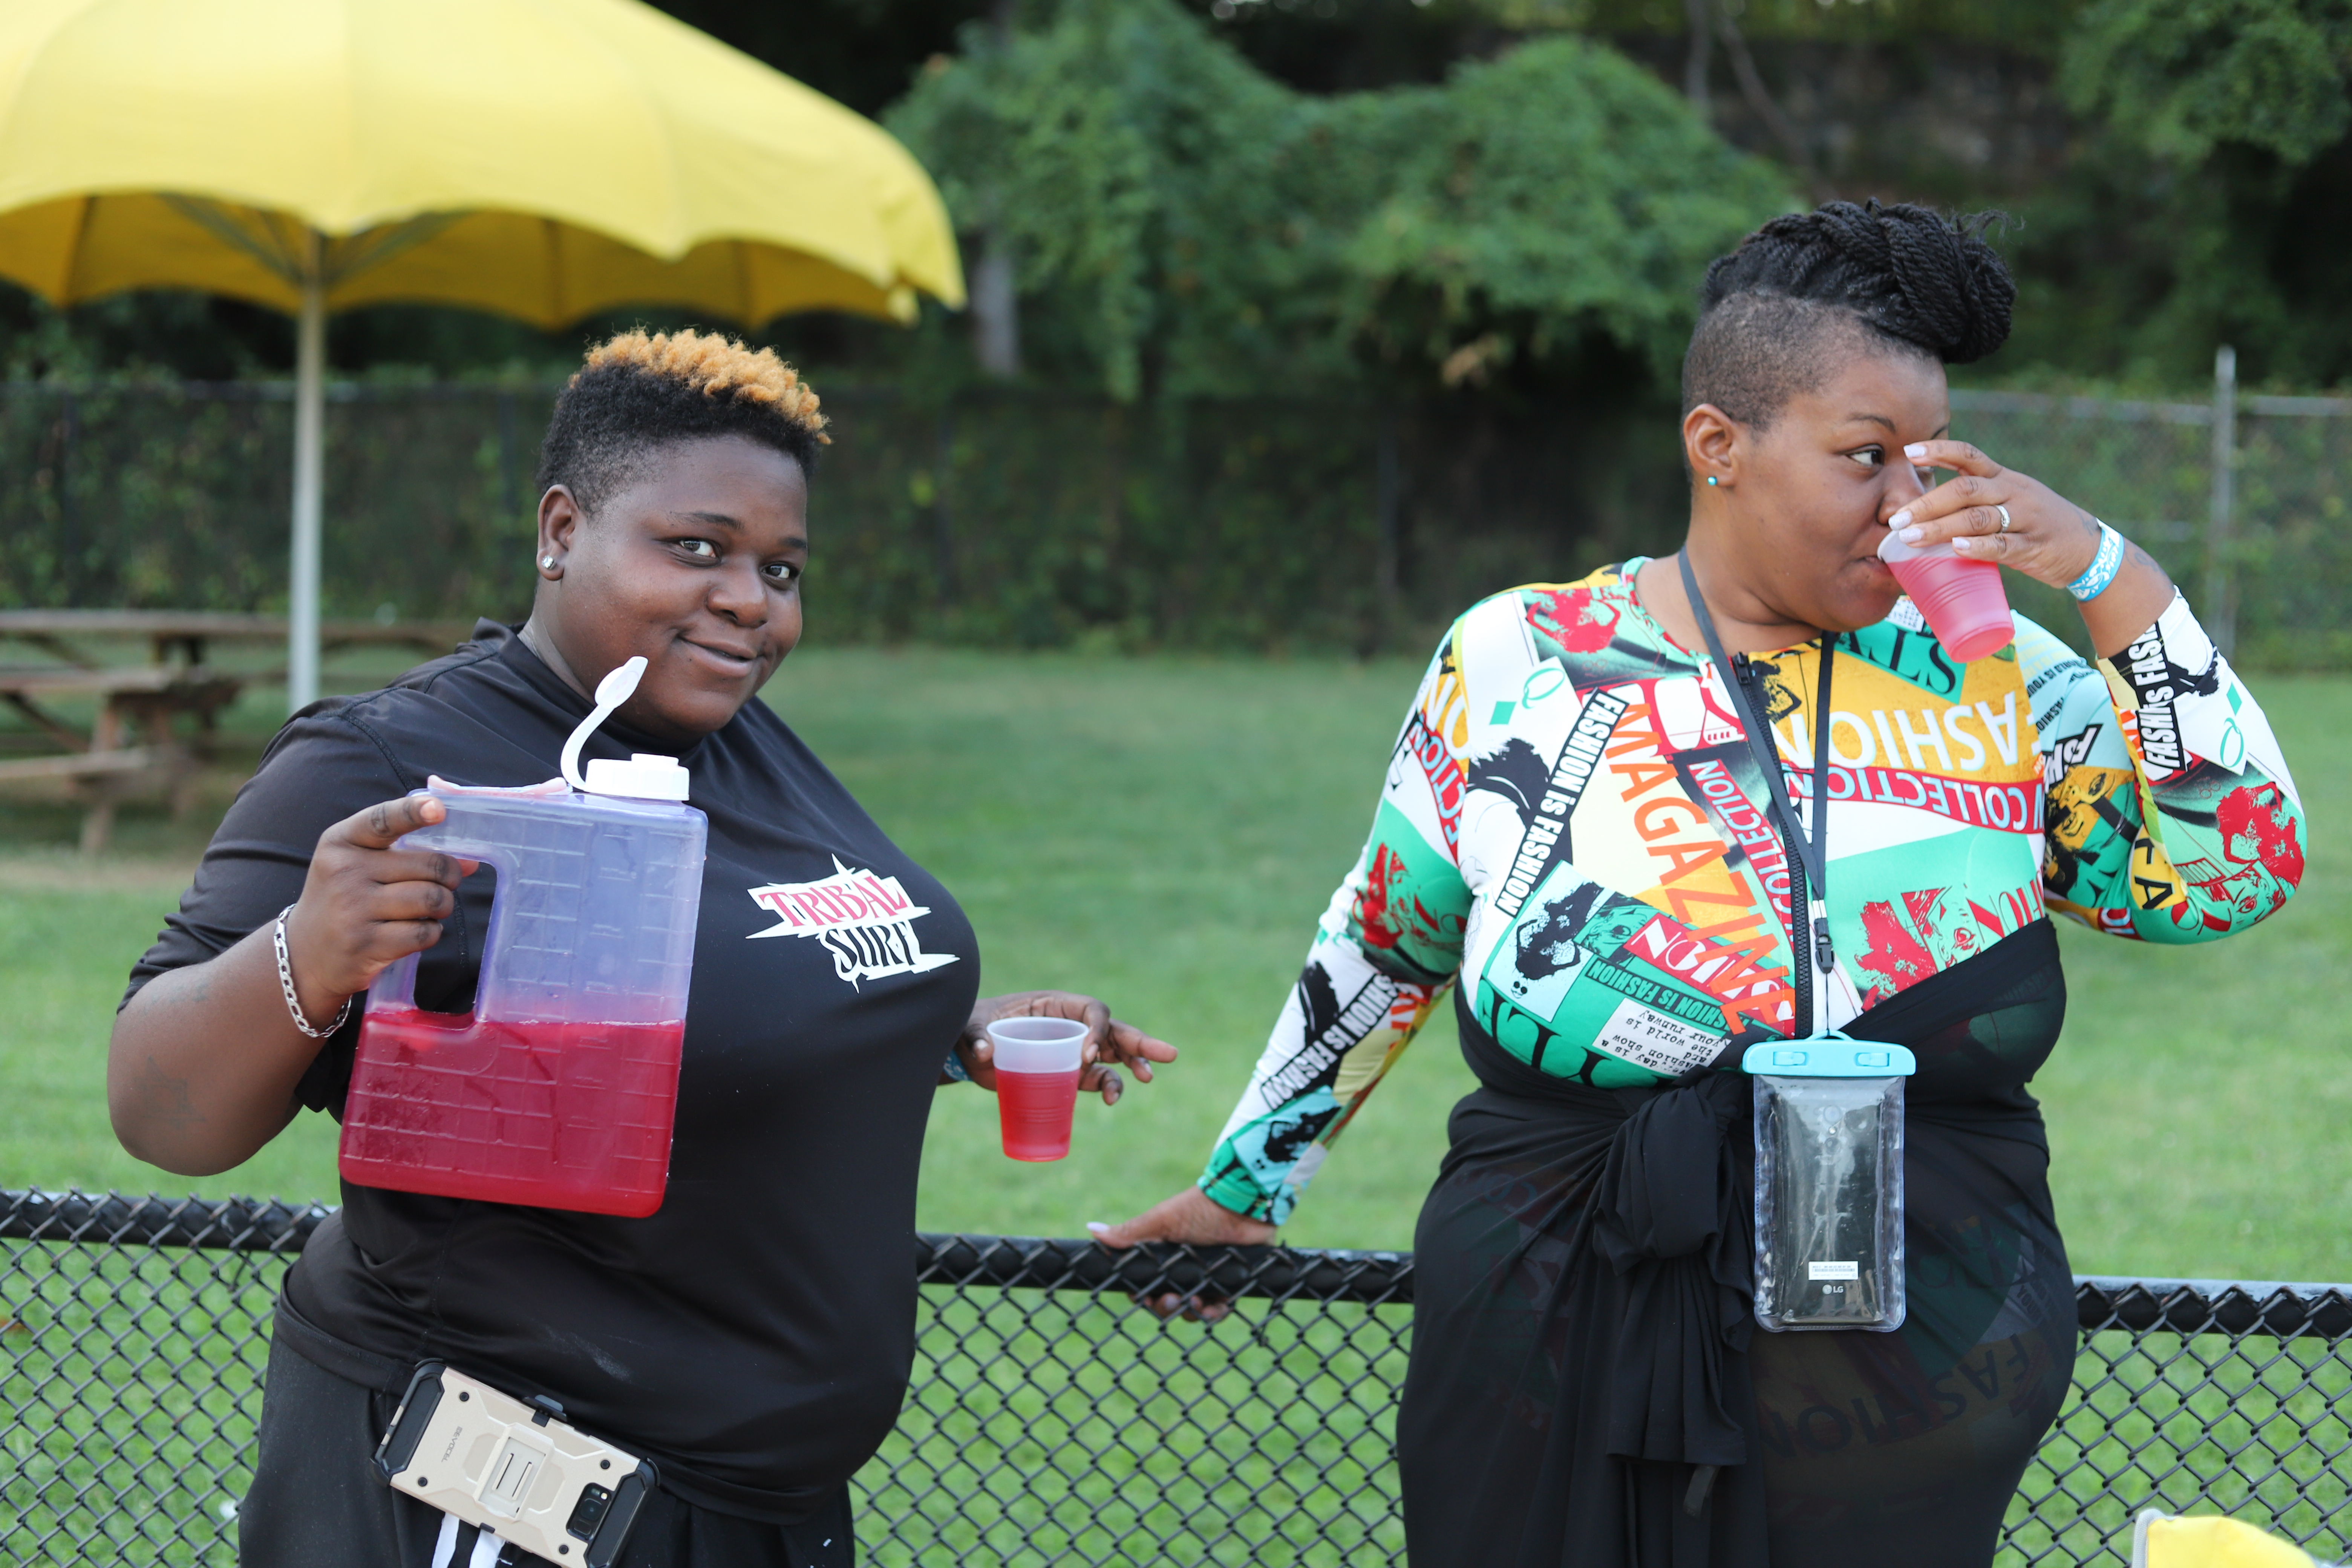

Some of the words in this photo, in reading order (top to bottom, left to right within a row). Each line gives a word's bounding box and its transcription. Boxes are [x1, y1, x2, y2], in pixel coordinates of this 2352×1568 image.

[1552, 693, 1626, 793] FASHION
[1768, 692, 2021, 772] ASHION
[1783, 767, 2027, 830] COLLECTION
[1497, 815, 1564, 916] FASHION
[1605, 703, 1795, 1035] MAGAZINE
[758, 876, 908, 927] TRIBAL
[825, 922, 916, 972] SURF
[1588, 959, 1654, 1003] FASHION
[1348, 975, 1403, 1037] SHION
[1638, 1011, 1686, 1034] runway
[1626, 1018, 1641, 1029] is
[1647, 1026, 1685, 1046] world
[1689, 1033, 1722, 1047] your
[1601, 1039, 1608, 1048] a
[1612, 1034, 1642, 1052] show
[1615, 1046, 1630, 1055] is
[1692, 1044, 1713, 1057] the
[1635, 1053, 1657, 1069] day
